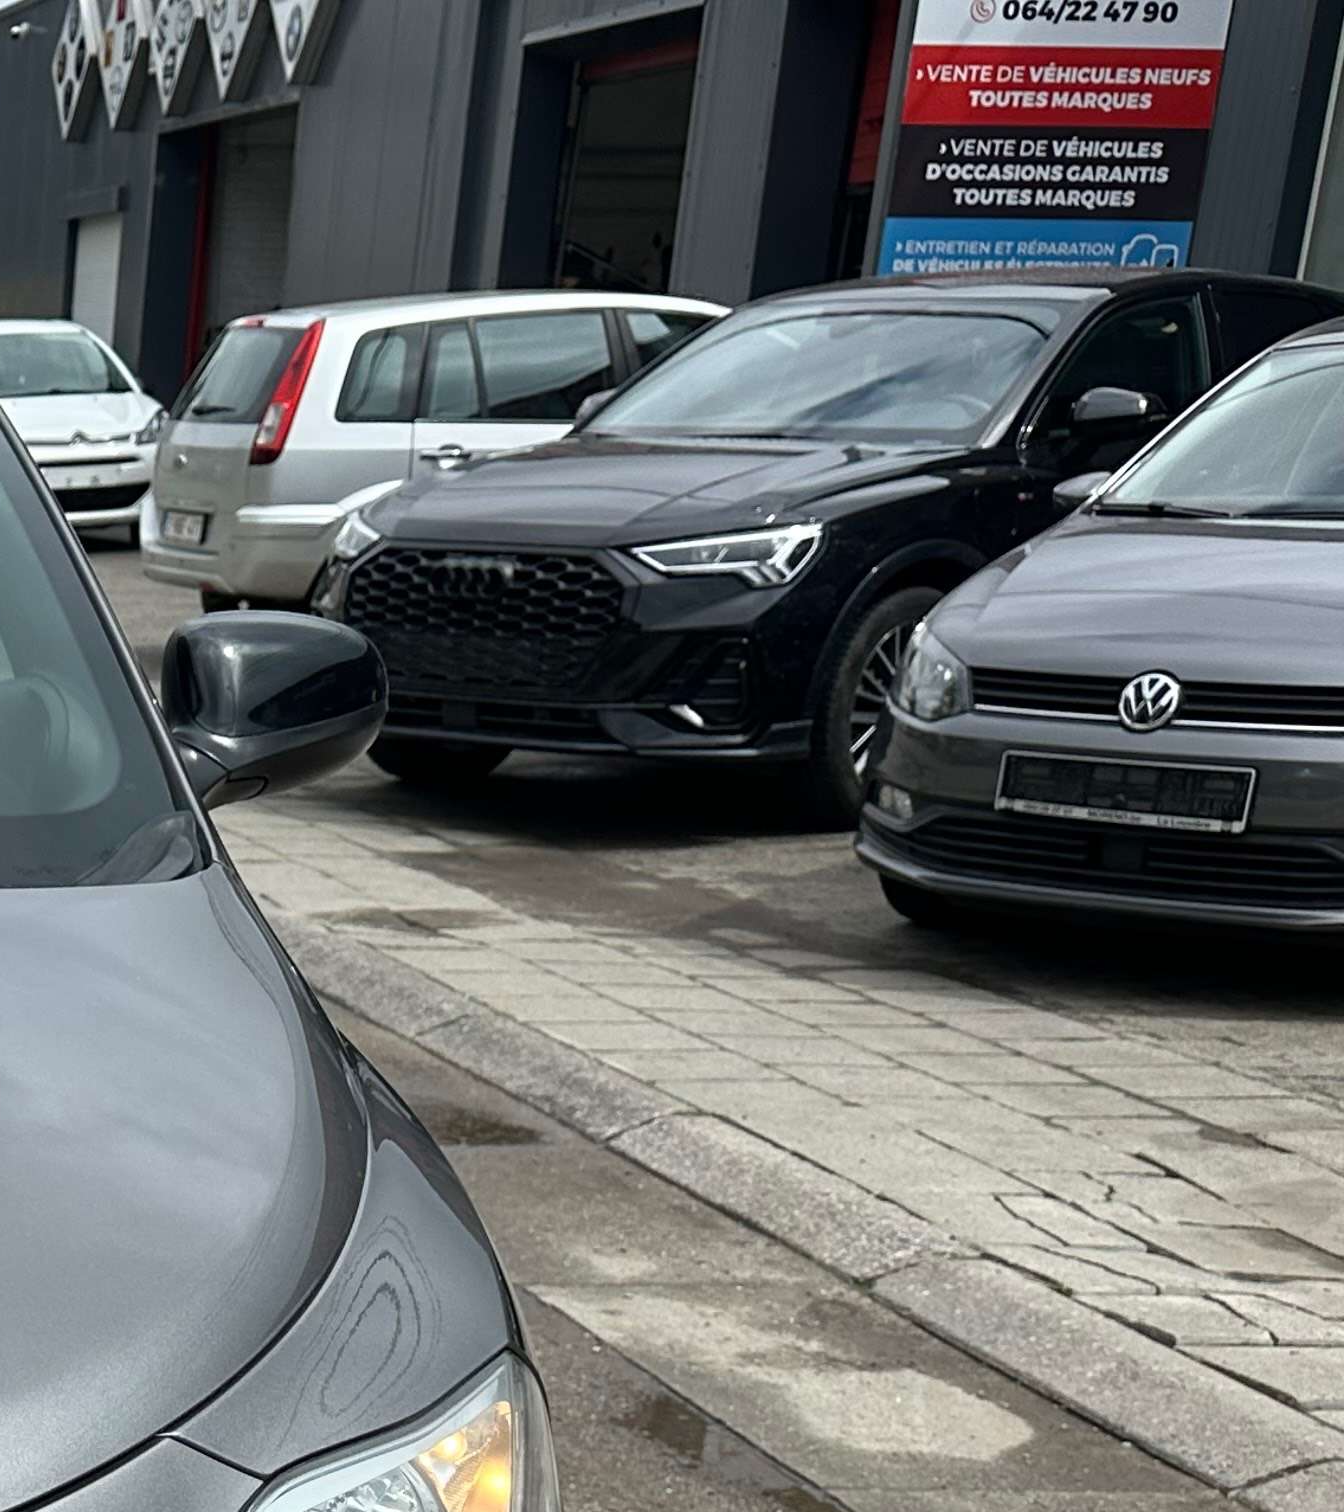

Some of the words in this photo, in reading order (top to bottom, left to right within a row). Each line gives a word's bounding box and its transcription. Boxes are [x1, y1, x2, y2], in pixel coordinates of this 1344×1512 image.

[1104, 1, 1136, 22] 47
[1142, 1, 1179, 23] 90
[927, 64, 994, 83] VENTE
[996, 66, 1025, 83] DE
[1029, 61, 1141, 85] VÉHICULES
[1145, 67, 1211, 86] NEUFS
[969, 90, 1049, 108] TOUTES
[1051, 91, 1152, 111] MARQUES
[950, 139, 1015, 157] VENTE
[1019, 140, 1047, 157] DE
[1051, 136, 1164, 159] VÉHICULES
[926, 164, 1063, 181] D'OCCASIONS
[1066, 165, 1169, 184] GARANTIS
[953, 188, 1031, 206] TOUTES
[1035, 189, 1136, 210] MARQUES
[905, 239, 991, 255] ENTRETIEN
[994, 240, 1014, 255] ET
[1016, 238, 1116, 256] RÉPARATION
